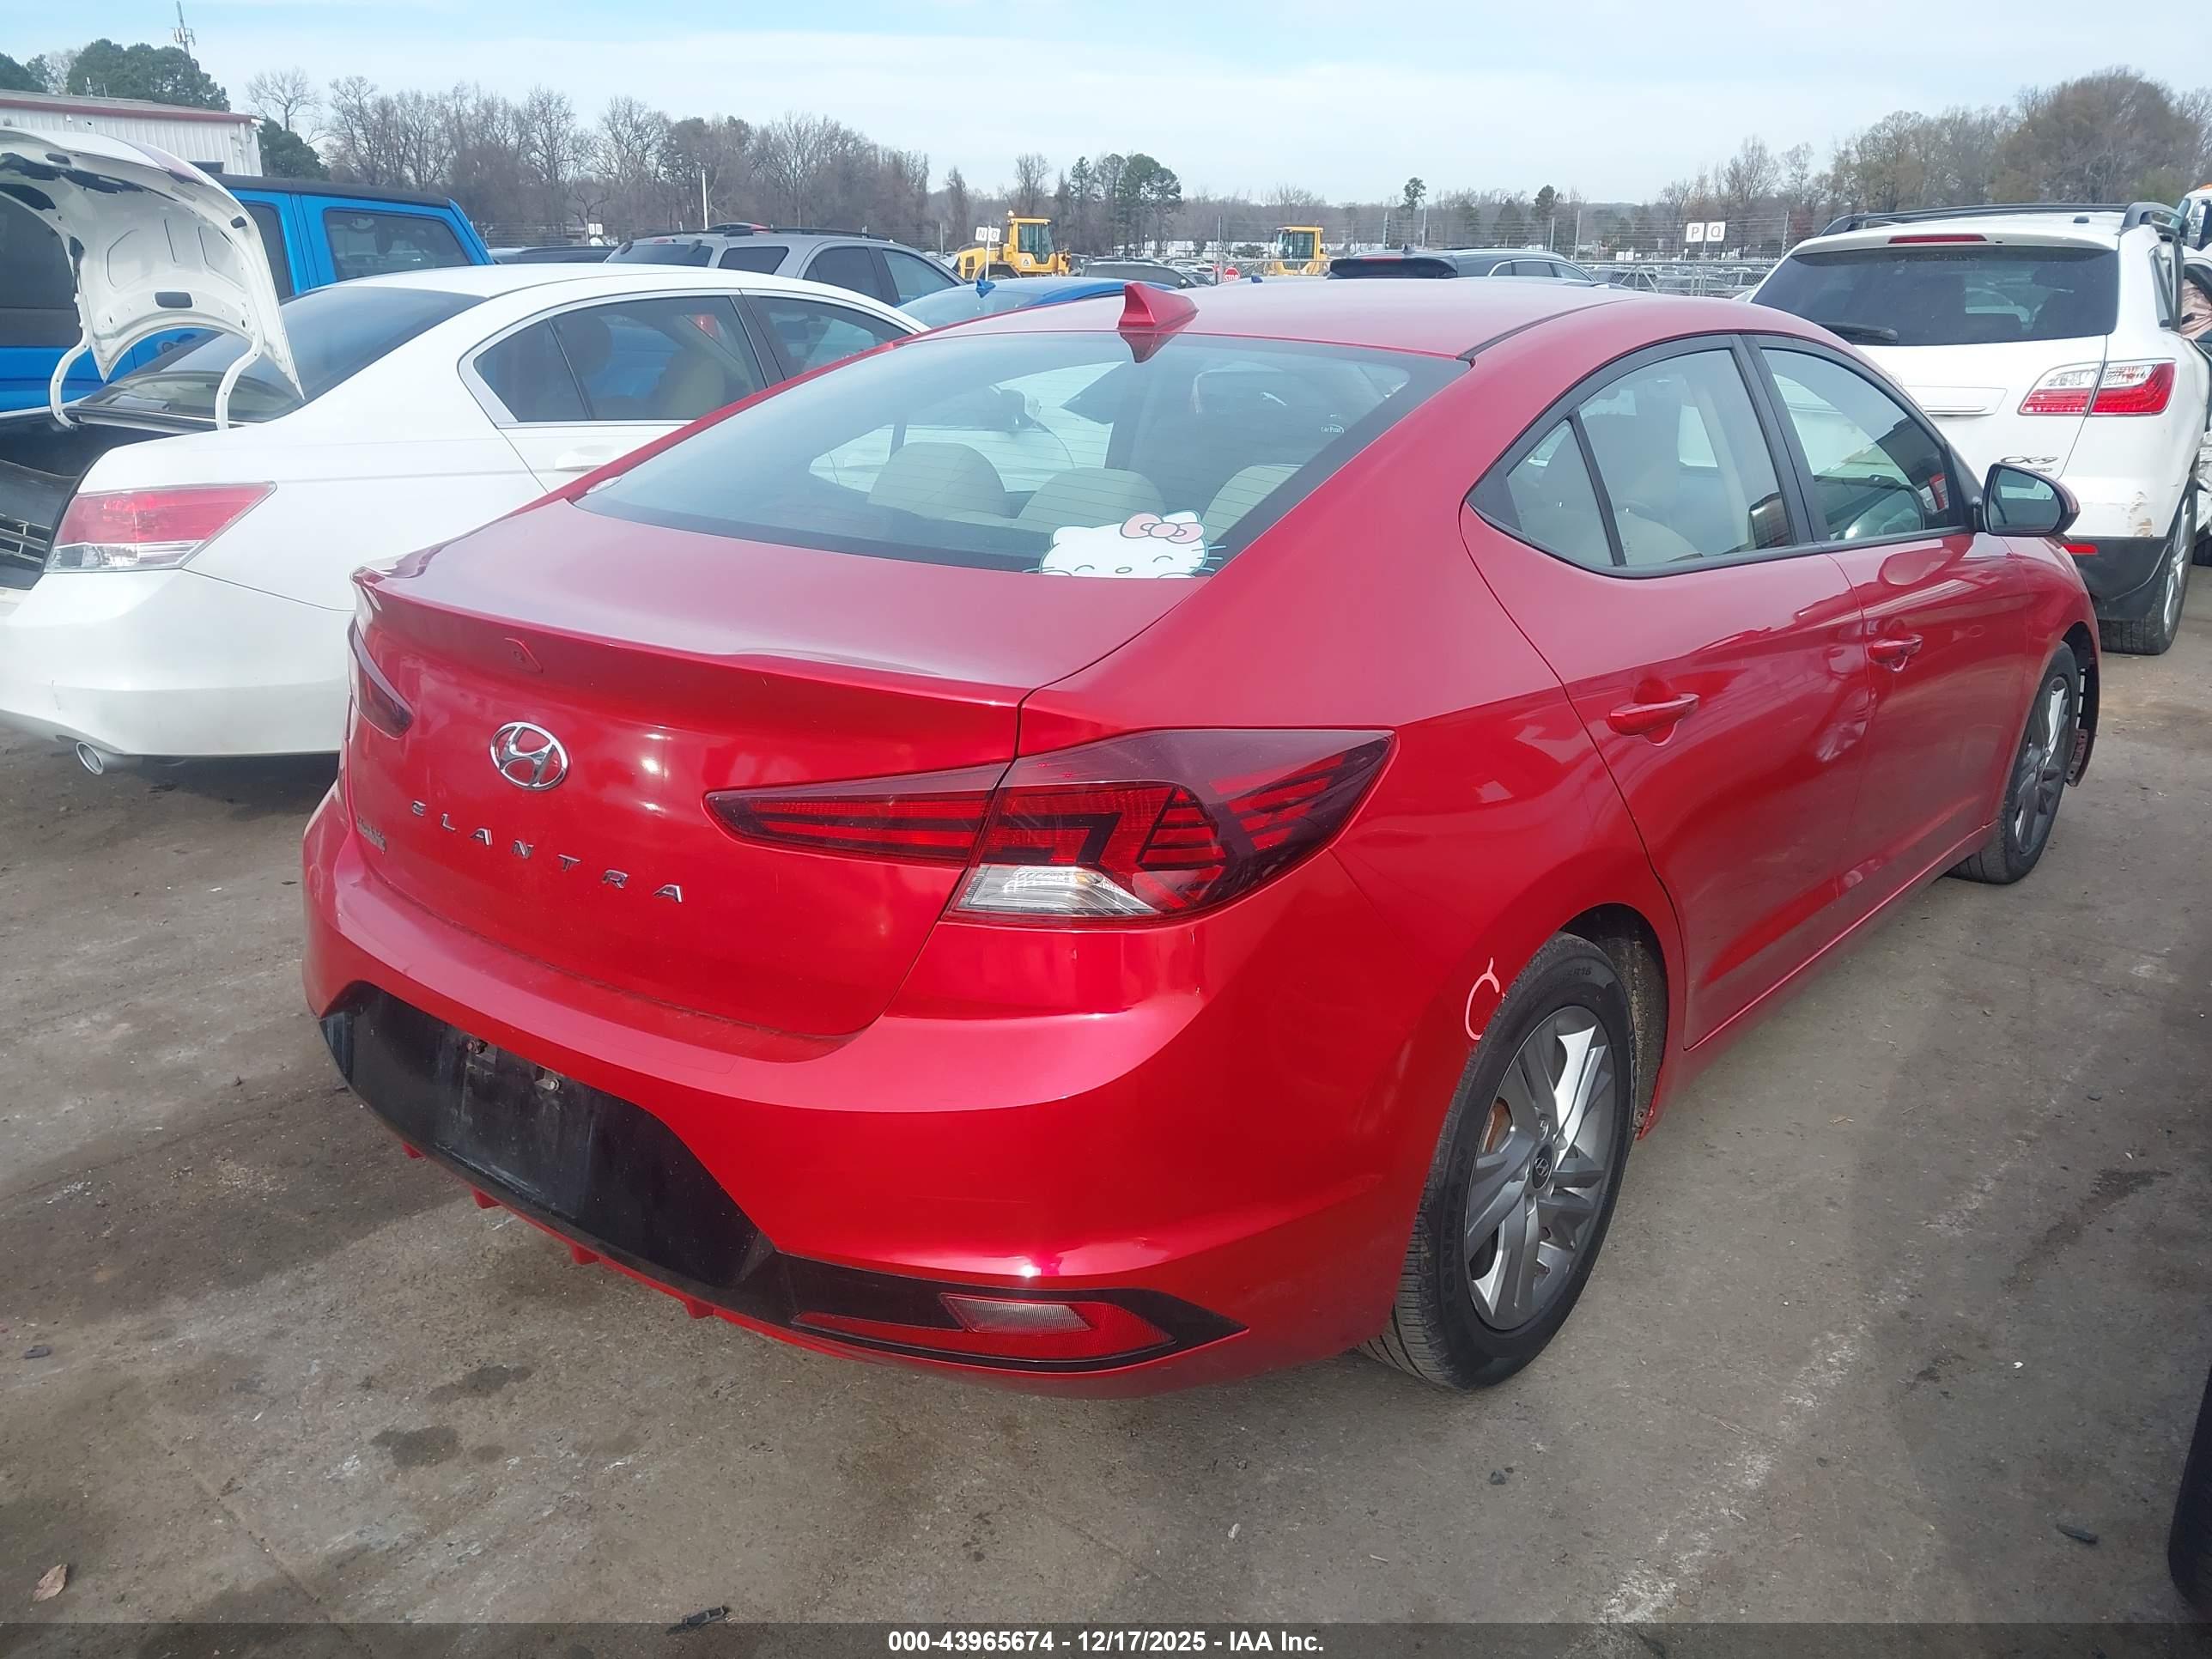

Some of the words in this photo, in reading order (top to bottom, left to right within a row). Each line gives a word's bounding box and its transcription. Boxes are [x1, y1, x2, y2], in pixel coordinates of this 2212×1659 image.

[977, 228, 986, 239] N
[1692, 226, 1700, 239] P
[1711, 225, 1722, 238] Q
[411, 799, 684, 903] ELANTRA
